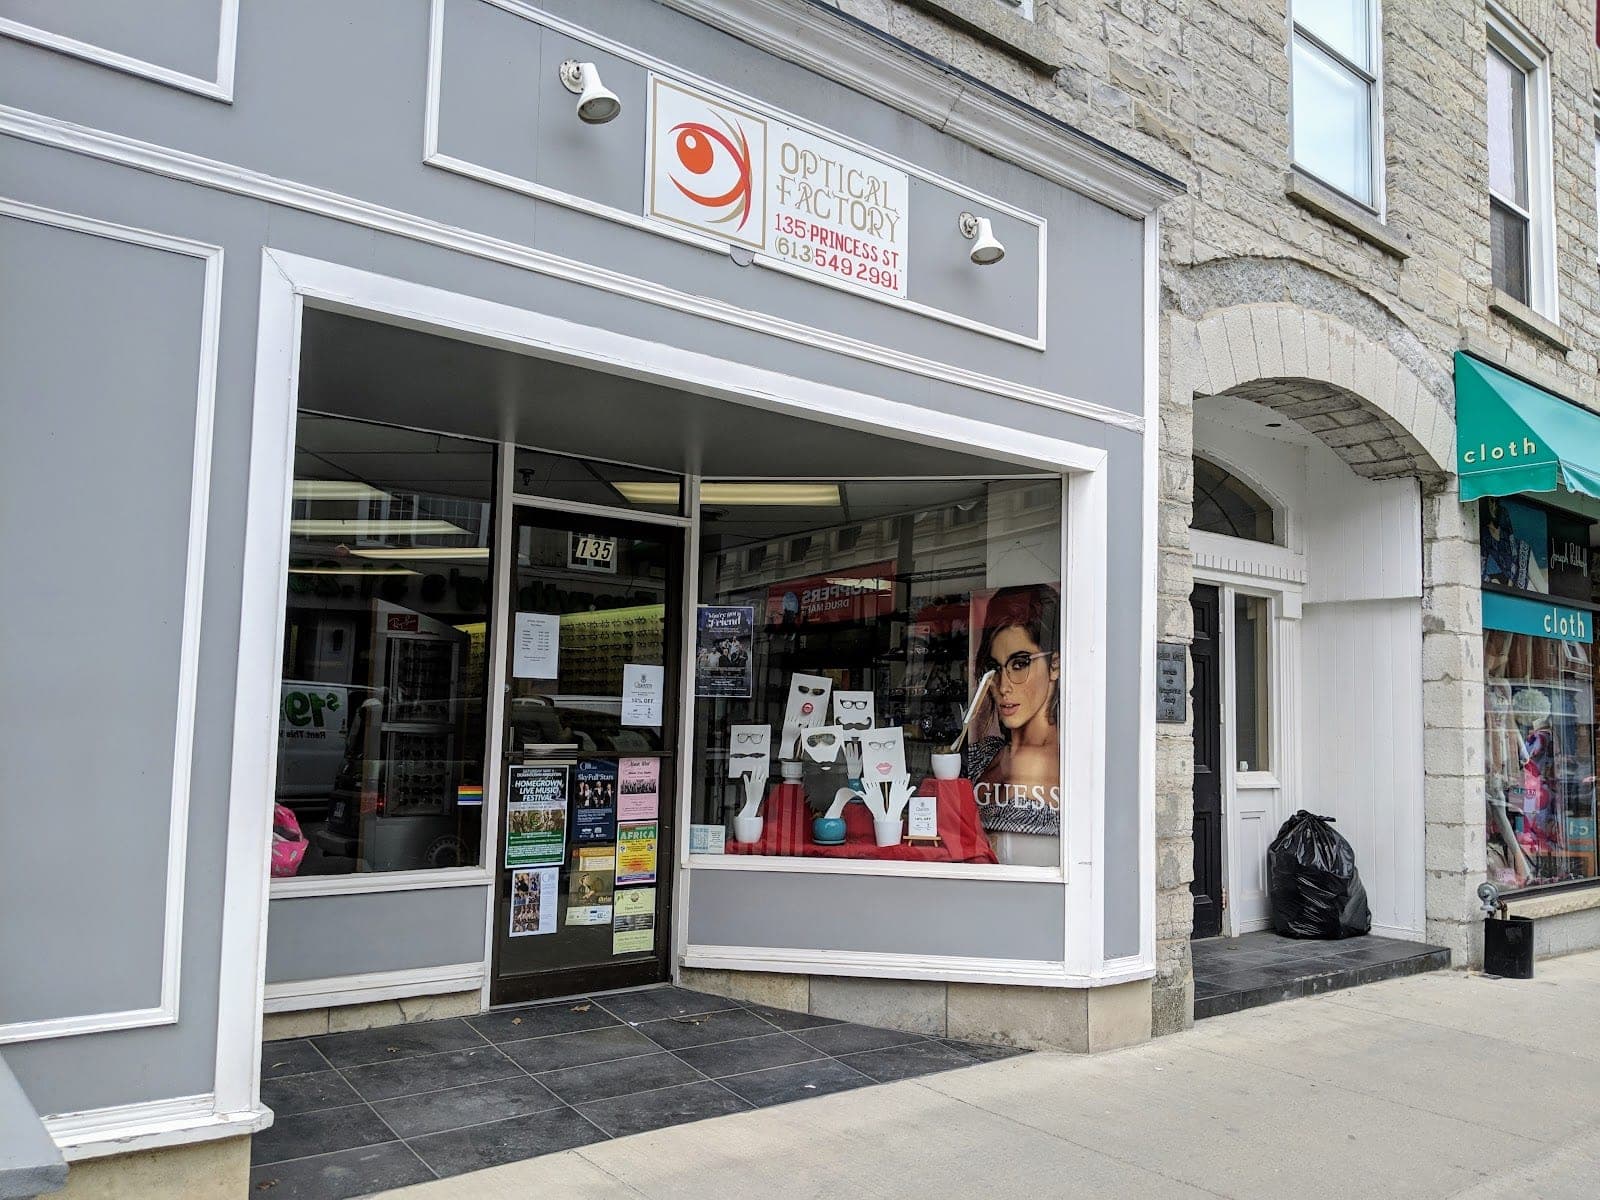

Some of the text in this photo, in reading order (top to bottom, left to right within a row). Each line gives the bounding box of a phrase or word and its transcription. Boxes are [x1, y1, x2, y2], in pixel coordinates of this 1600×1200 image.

[780, 142, 897, 213] OPTICAL
[776, 174, 901, 243] FACTORY
[775, 213, 899, 269] 135 PRINCESS ST
[775, 235, 898, 290] (613) 549 2991
[1463, 437, 1537, 464] cloth
[580, 540, 612, 559] 135
[1543, 607, 1585, 638] cloth
[514, 779, 563, 788] HOMEGROWN
[522, 794, 553, 802] FESTIVAL
[973, 782, 1060, 811] GUESS
[620, 830, 655, 840] AFRICA
